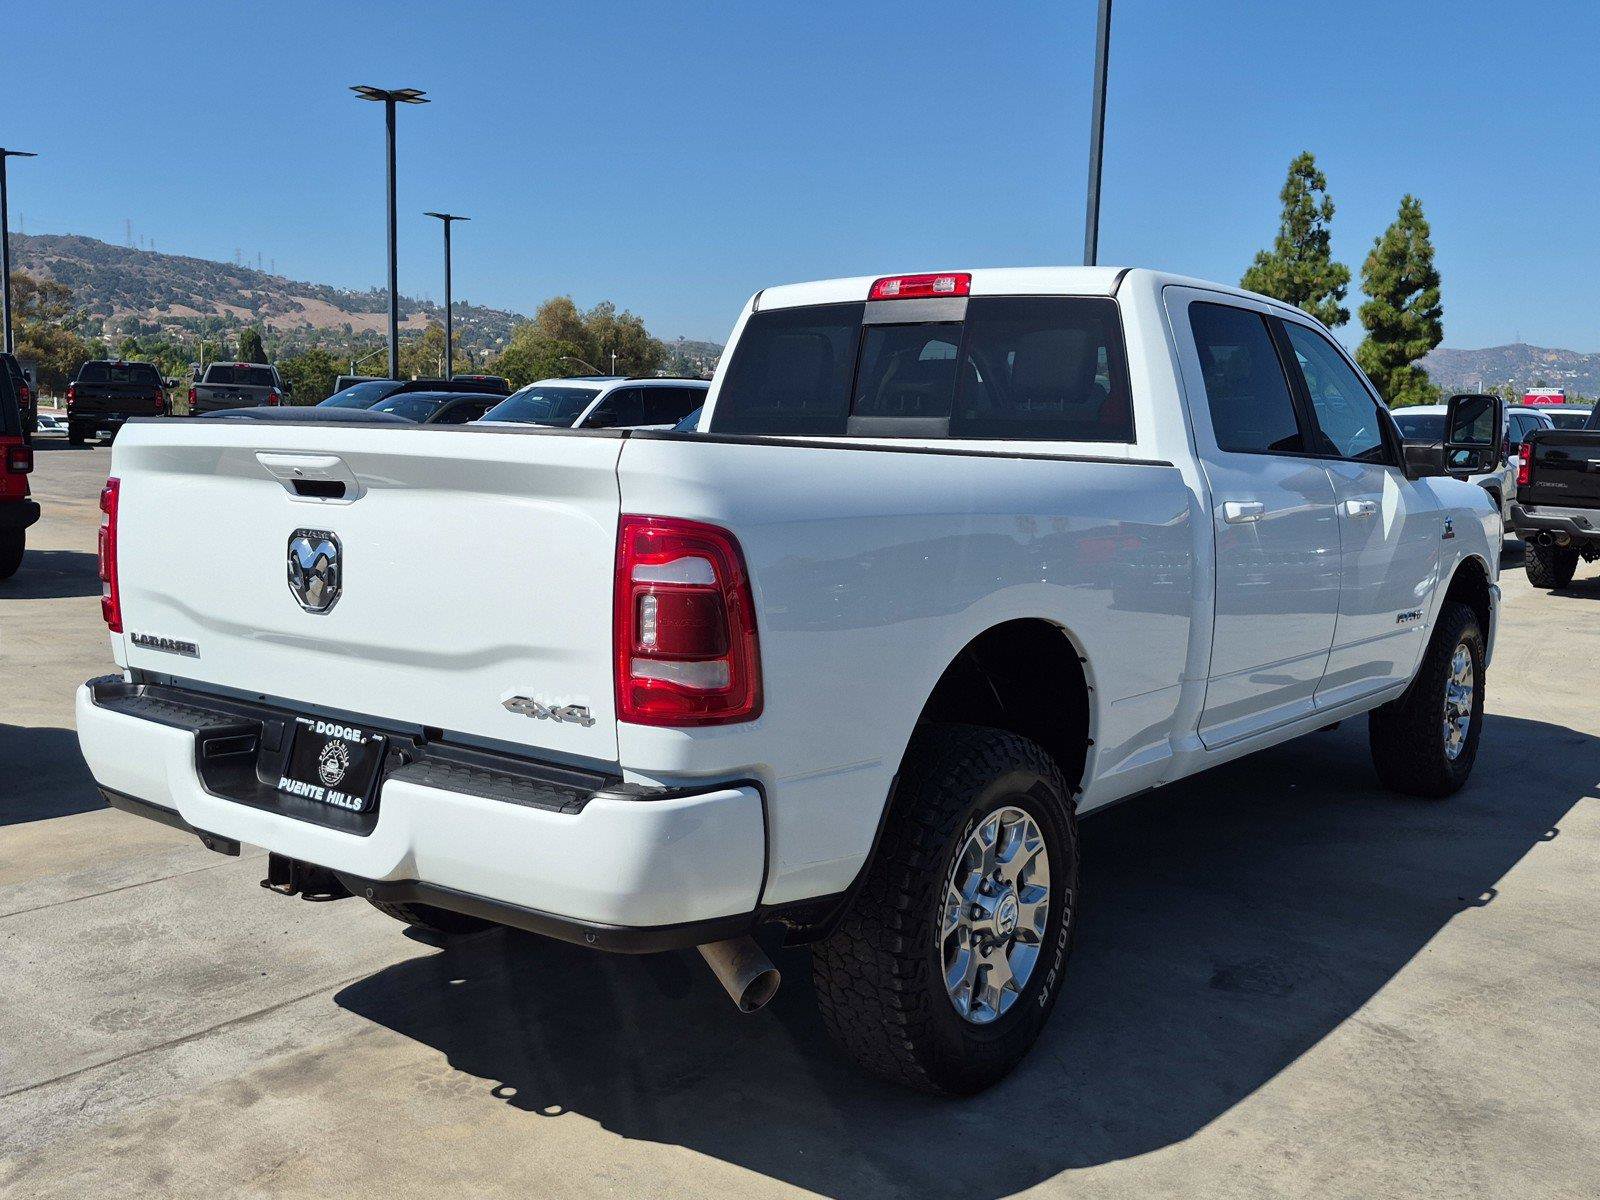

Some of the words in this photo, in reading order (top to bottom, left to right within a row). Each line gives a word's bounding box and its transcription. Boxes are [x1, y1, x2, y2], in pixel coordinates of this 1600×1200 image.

[316, 721, 361, 742] DODGE
[278, 777, 325, 800] PUENTE
[326, 790, 362, 811] HILLS
[1038, 887, 1073, 1008] COOPER
